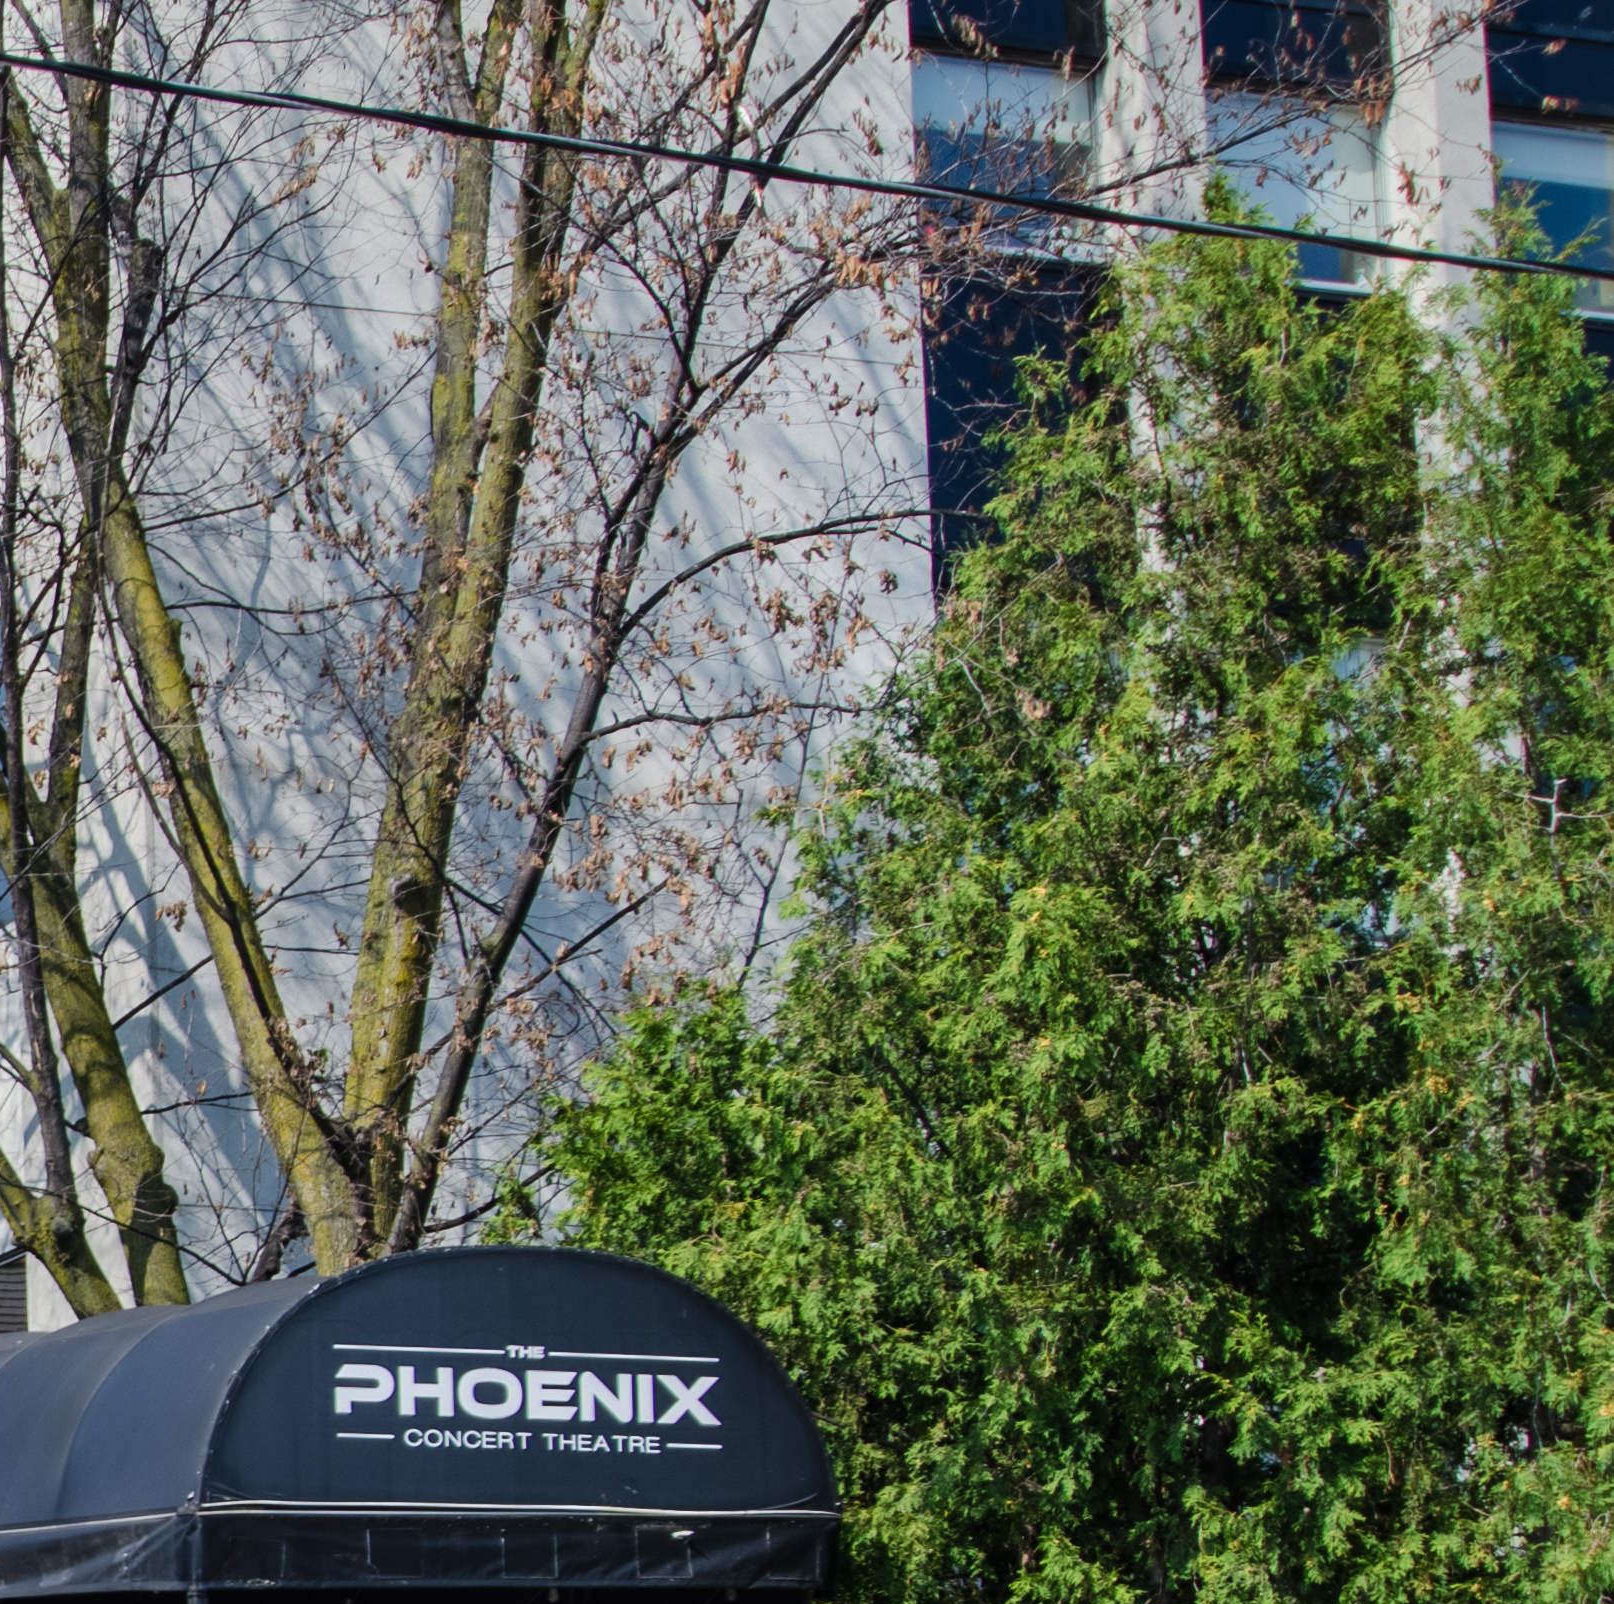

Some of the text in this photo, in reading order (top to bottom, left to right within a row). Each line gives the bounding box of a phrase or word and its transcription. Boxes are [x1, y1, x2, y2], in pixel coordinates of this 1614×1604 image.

[505, 1344, 546, 1359] THE
[334, 1362, 723, 1427] PHOENIX
[402, 1427, 662, 1454] CONCERT THEATRE
